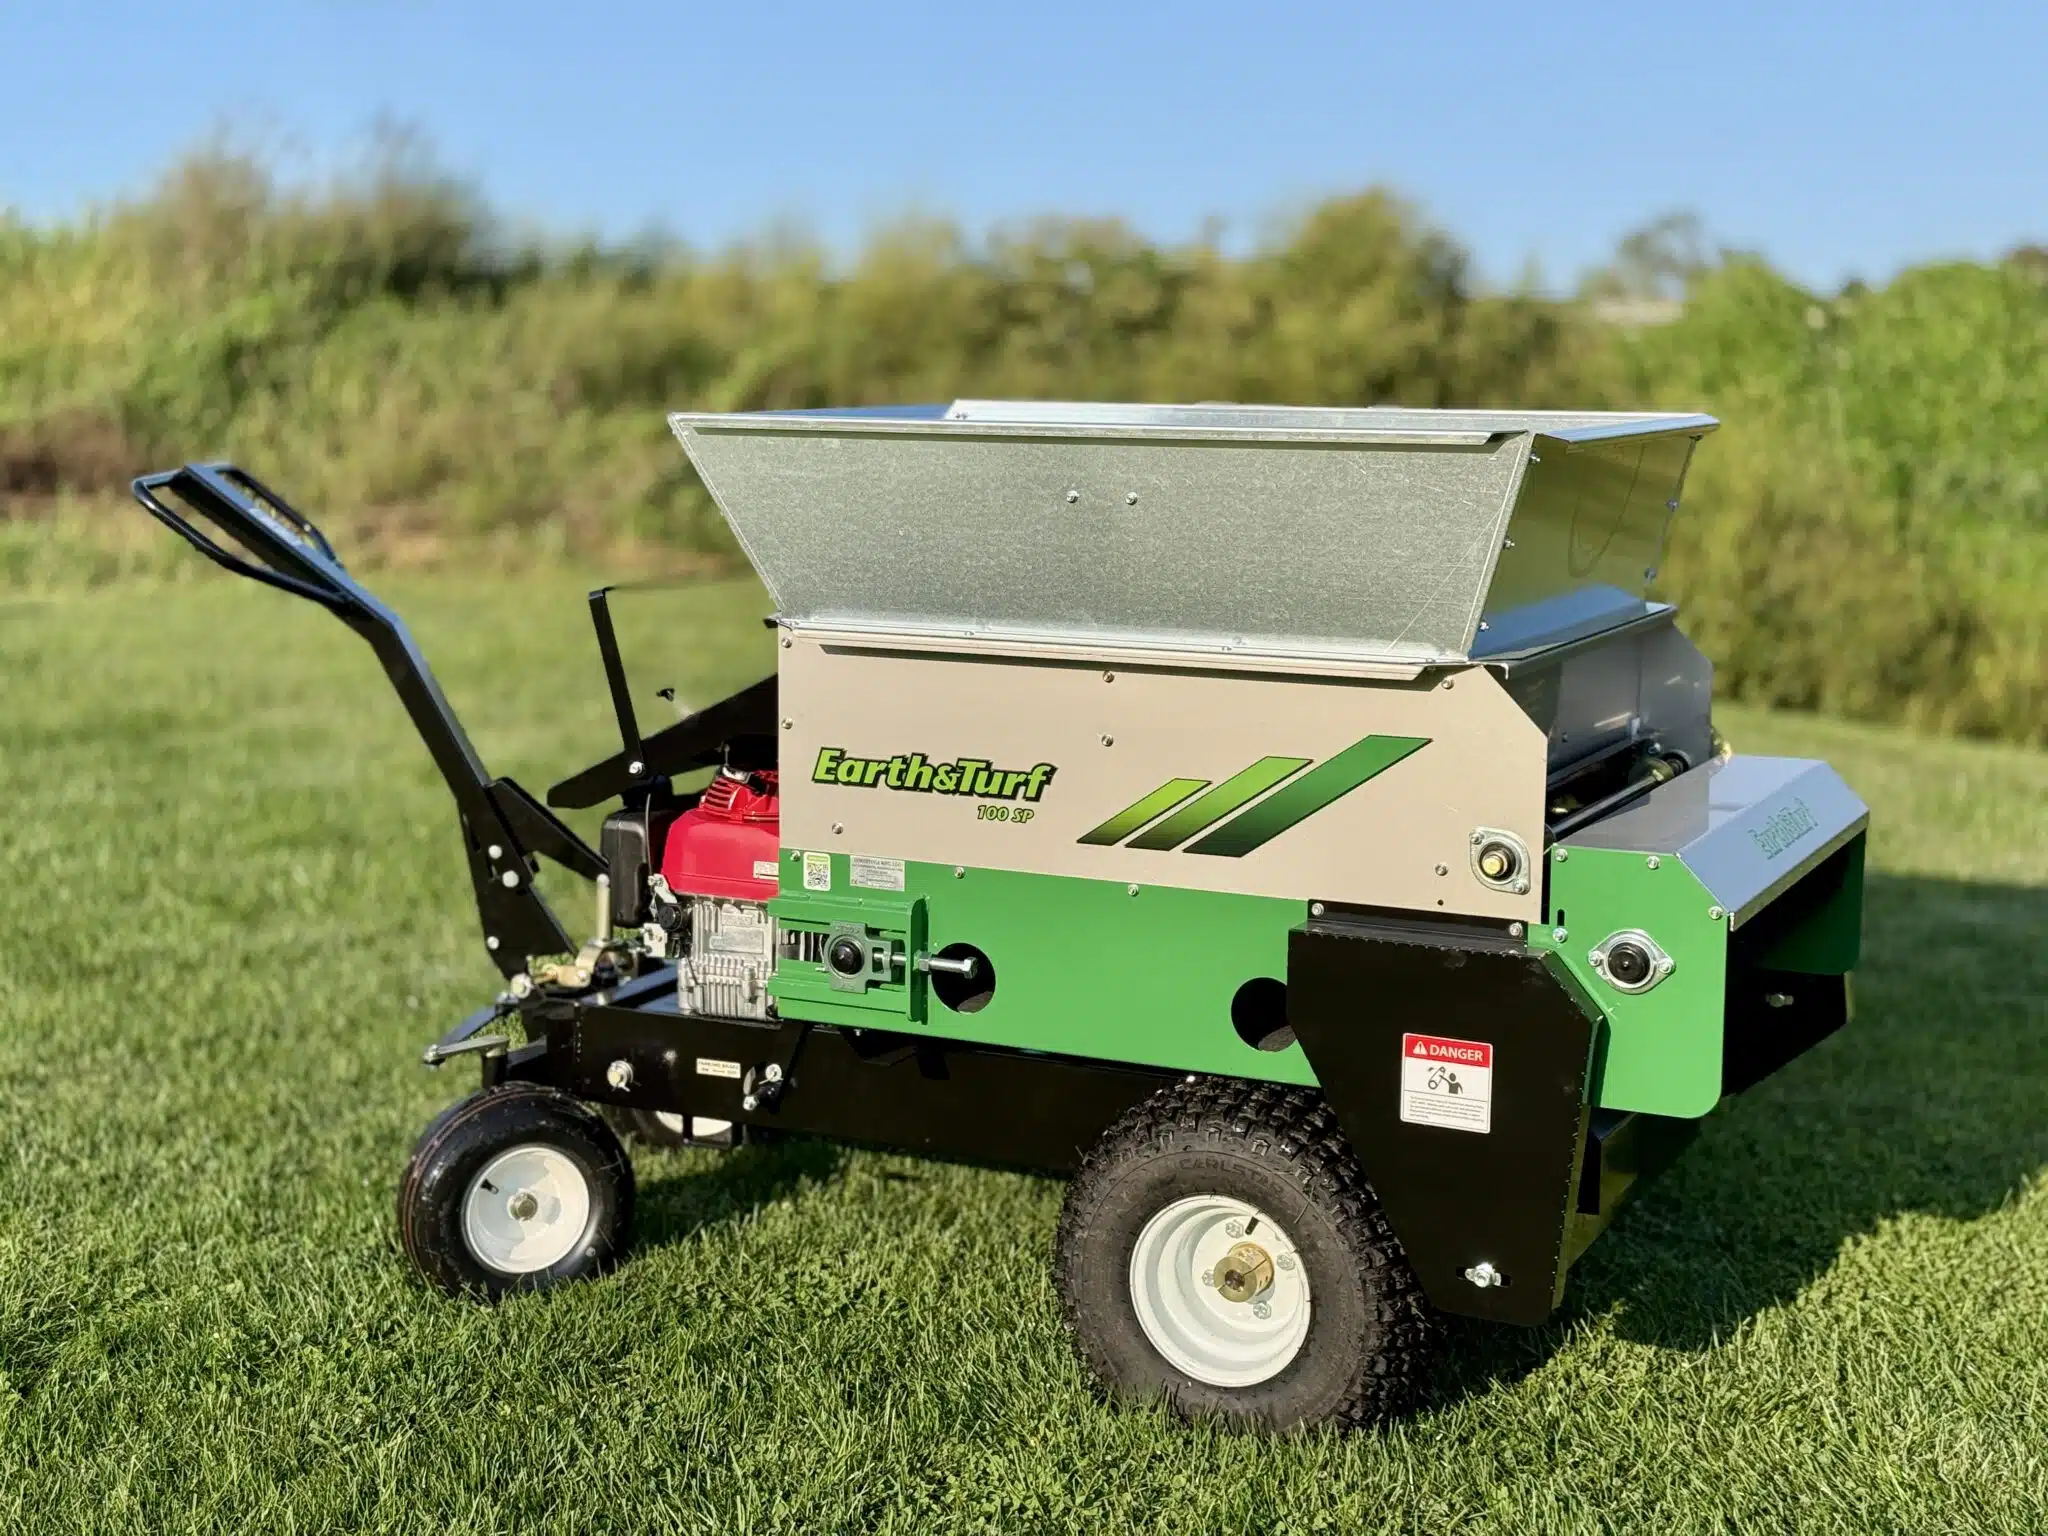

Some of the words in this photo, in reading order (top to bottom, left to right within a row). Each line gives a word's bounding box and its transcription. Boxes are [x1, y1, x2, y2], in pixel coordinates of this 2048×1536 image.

[812, 746, 1058, 802] Earth&Turf
[977, 804, 1009, 822] 100
[1011, 807, 1035, 823] SP
[1429, 1044, 1483, 1062] DANGER
